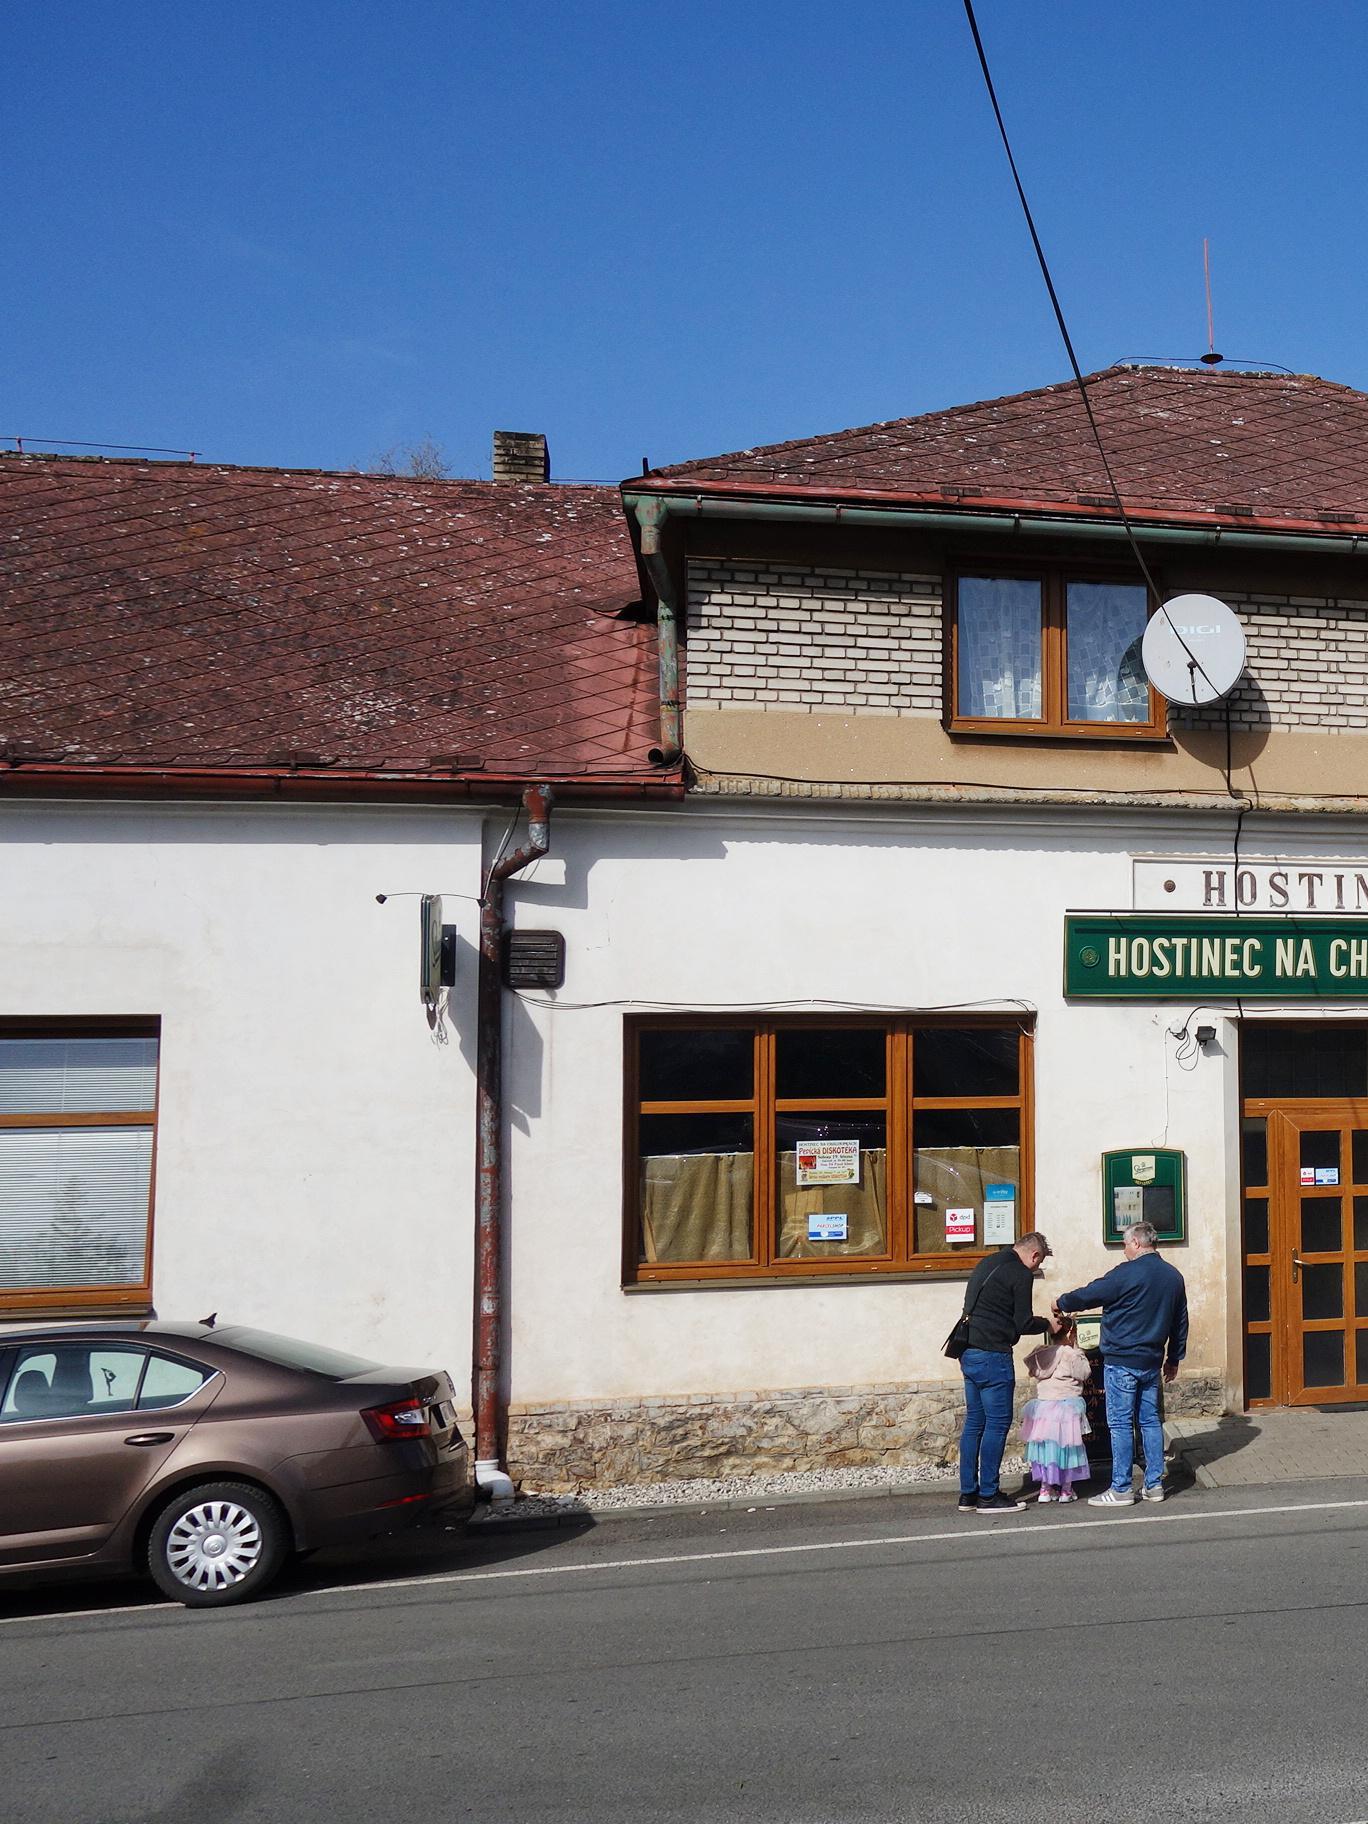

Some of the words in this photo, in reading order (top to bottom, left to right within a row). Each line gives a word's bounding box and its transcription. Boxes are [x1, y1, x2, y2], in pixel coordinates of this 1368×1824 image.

[1107, 937, 1263, 978] HOSTINEC
[1275, 937, 1318, 978] NA
[822, 1146, 857, 1155] DISKOTEKA
